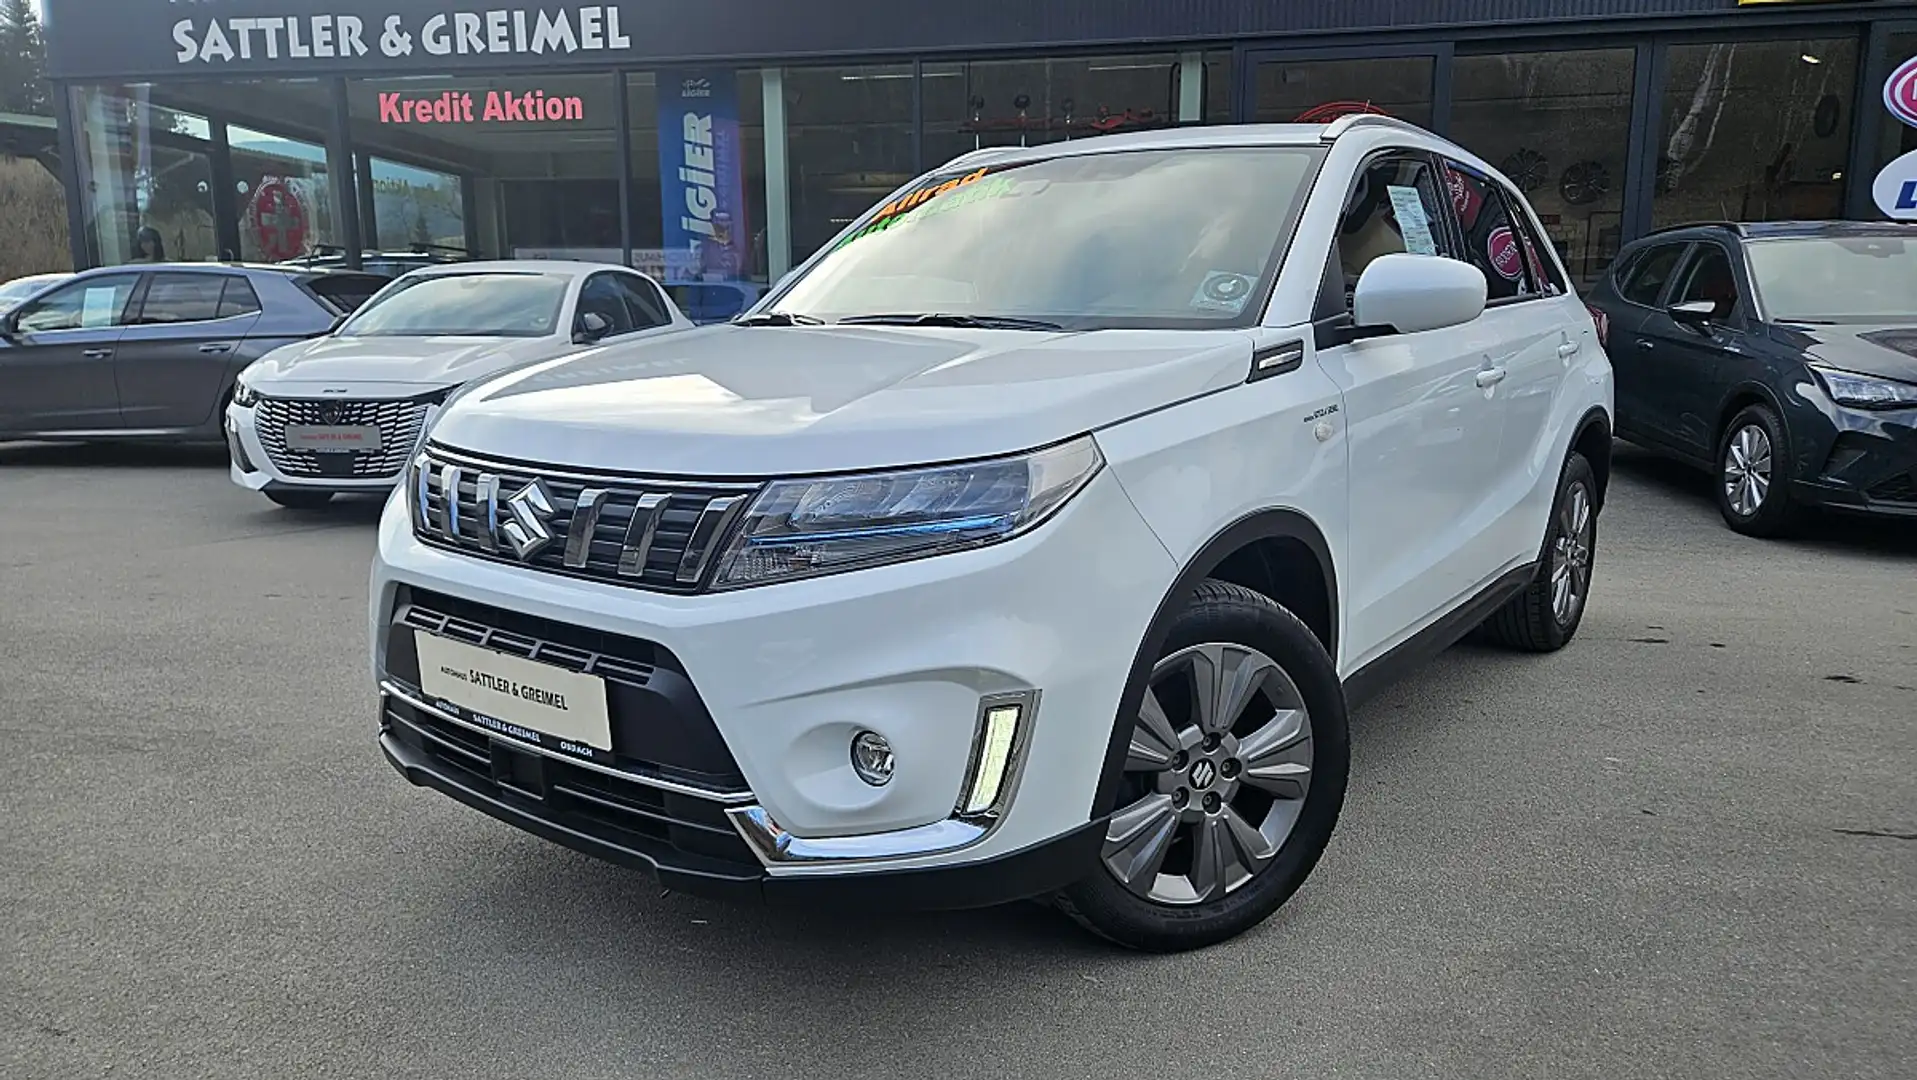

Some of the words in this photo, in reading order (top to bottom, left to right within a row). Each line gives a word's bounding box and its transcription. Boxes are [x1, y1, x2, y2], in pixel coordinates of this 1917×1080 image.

[172, 15, 368, 63] SATTLER
[380, 15, 412, 58] &
[421, 6, 631, 55] GREIMEL
[378, 91, 474, 123] Kredit
[483, 90, 584, 121] Aktion
[871, 167, 989, 224] Allrad
[469, 669, 510, 694] SATTLER
[512, 682, 520, 696] &
[521, 685, 568, 710] GREIMEL
